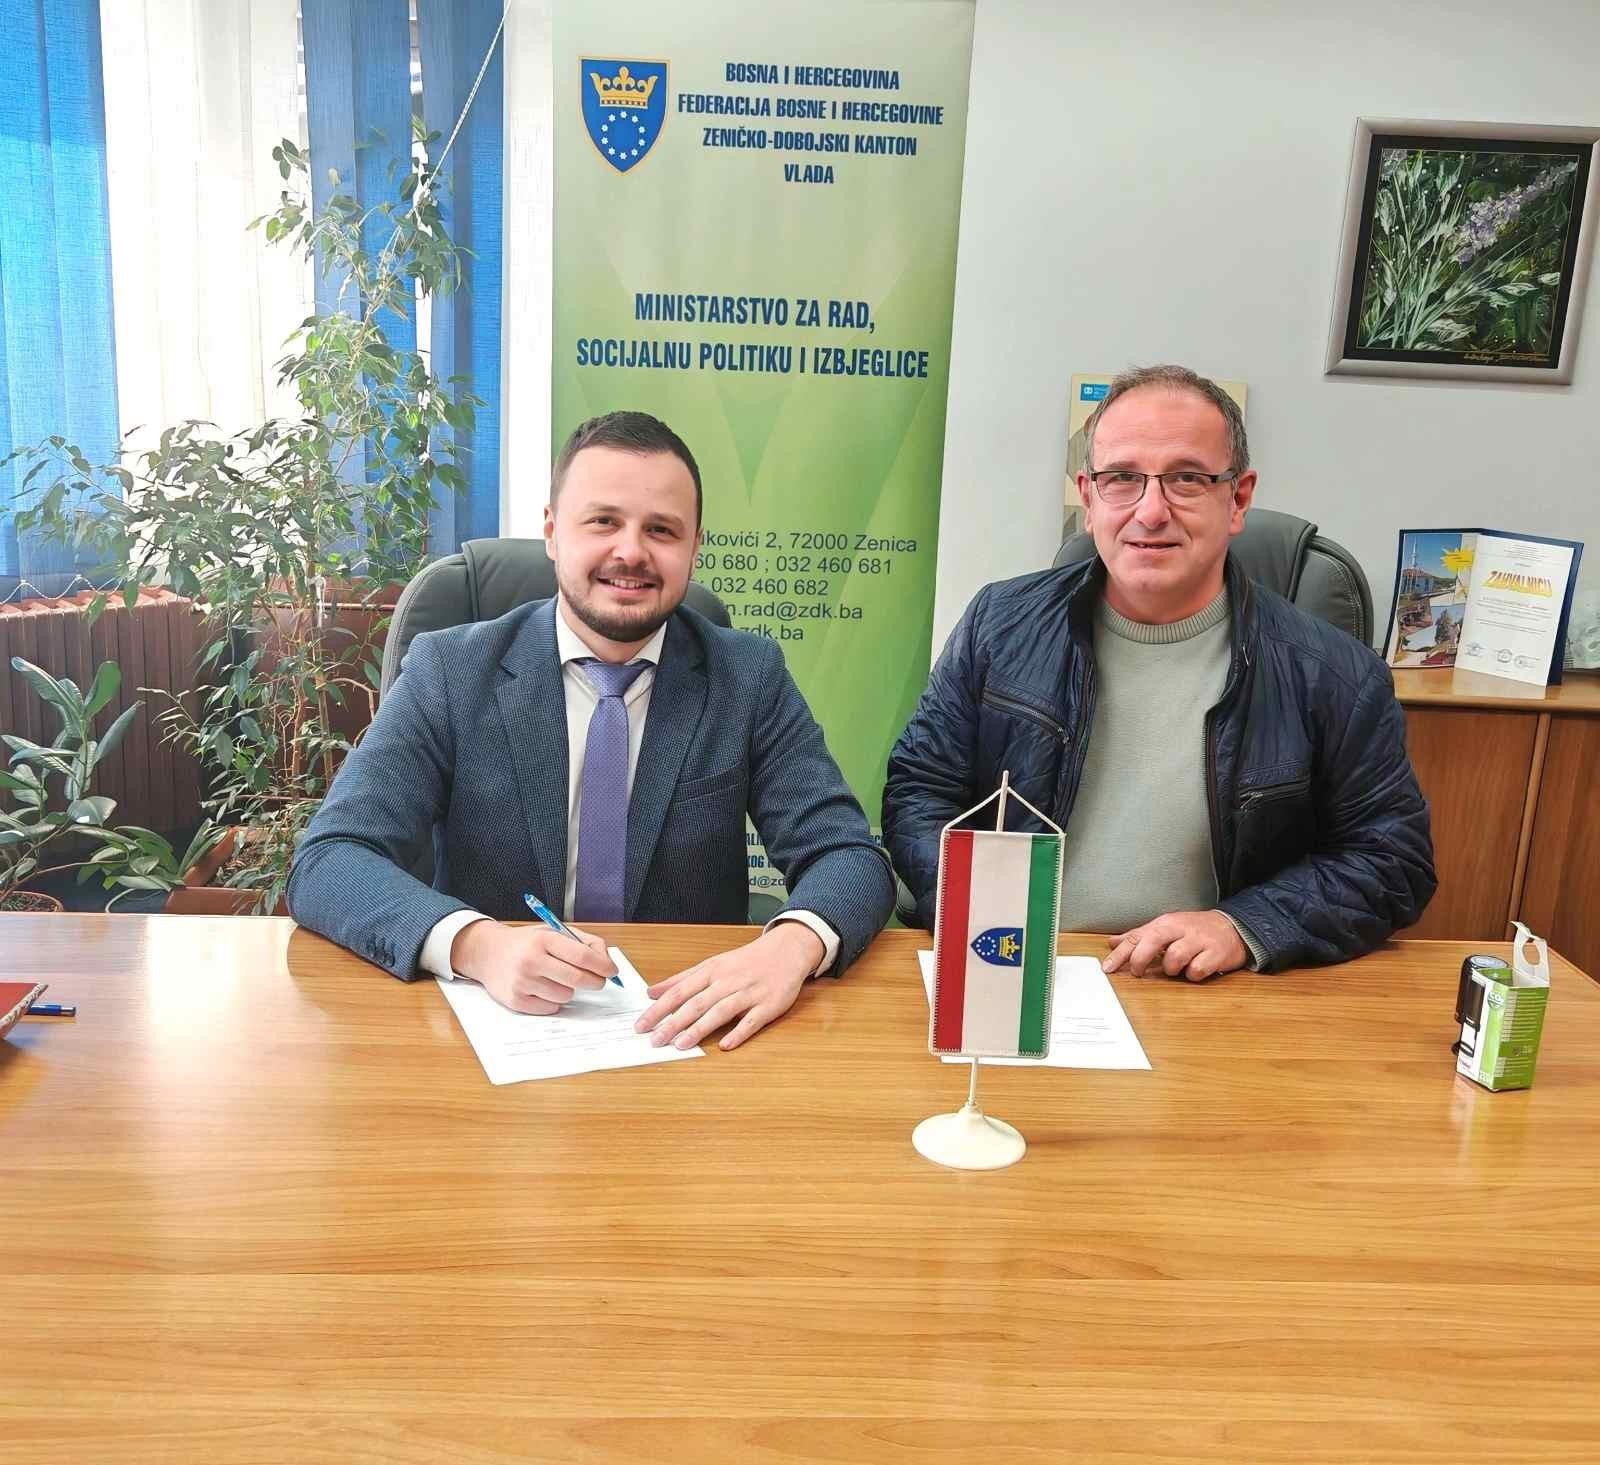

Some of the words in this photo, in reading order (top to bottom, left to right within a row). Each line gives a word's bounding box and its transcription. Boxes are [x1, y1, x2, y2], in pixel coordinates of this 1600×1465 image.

[725, 62, 779, 84] BOSNA
[784, 65, 790, 85] I
[794, 66, 900, 90] HERCEGOVINA
[678, 93, 771, 117] FEDERACIJA
[776, 98, 827, 119] BOSNE
[831, 101, 837, 120] I
[841, 101, 944, 125] HERCEGOVINE
[702, 125, 850, 152] ZENIČKO-DOBOJSKI
[854, 134, 918, 156] KANTON
[783, 163, 835, 184] VLADA
[635, 293, 788, 326] MINISTARSTVO
[795, 299, 821, 327] ZA
[828, 300, 875, 334] RAD,
[576, 338, 692, 369] SOCIJALNU
[699, 342, 792, 373] POLITIKU
[799, 347, 806, 374] I
[813, 347, 929, 378] IZBJEGLICE
[765, 532, 782, 551] 2,
[789, 532, 848, 550] 72000
[854, 534, 917, 552] Zenica
[722, 554, 758, 571] 680
[776, 555, 811, 572] 032
[817, 556, 852, 573] 460
[858, 558, 891, 574] 681
[711, 576, 746, 593] 032
[752, 578, 787, 594] 460
[794, 578, 828, 596] 682
